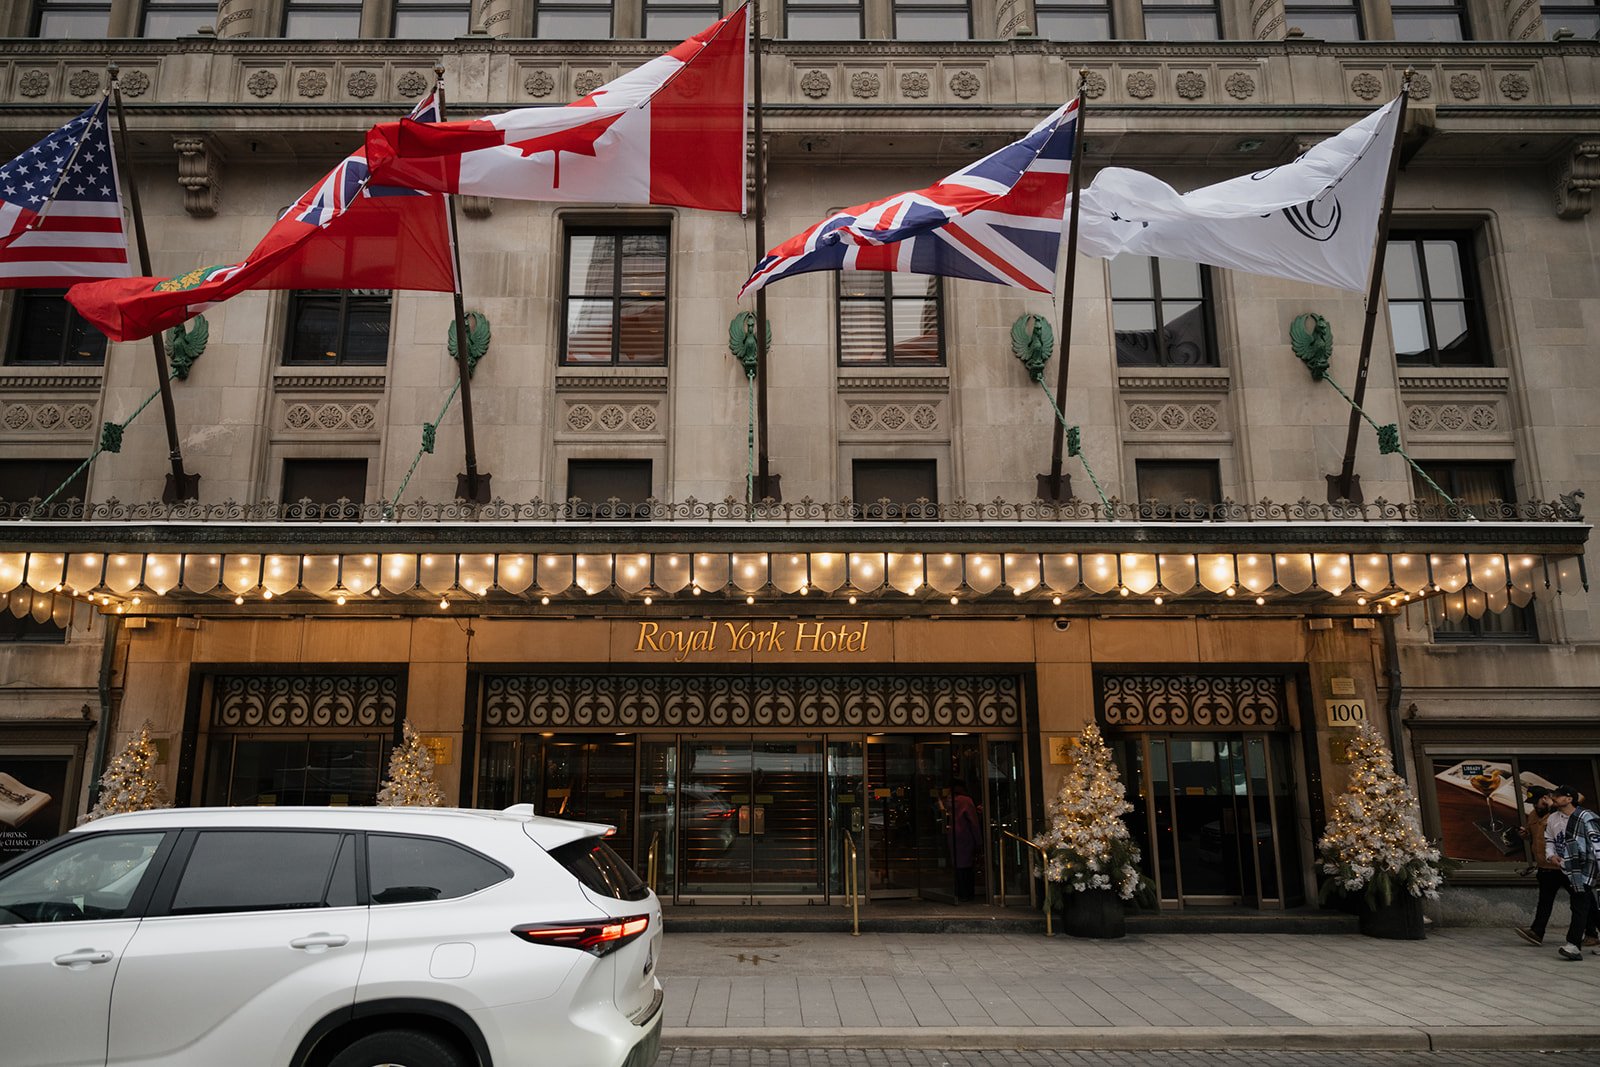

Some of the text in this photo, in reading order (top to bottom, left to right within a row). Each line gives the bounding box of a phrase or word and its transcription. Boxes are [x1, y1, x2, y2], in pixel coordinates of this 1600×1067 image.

[634, 621, 868, 662] Royal York Hotel
[1329, 704, 1363, 721] 100
